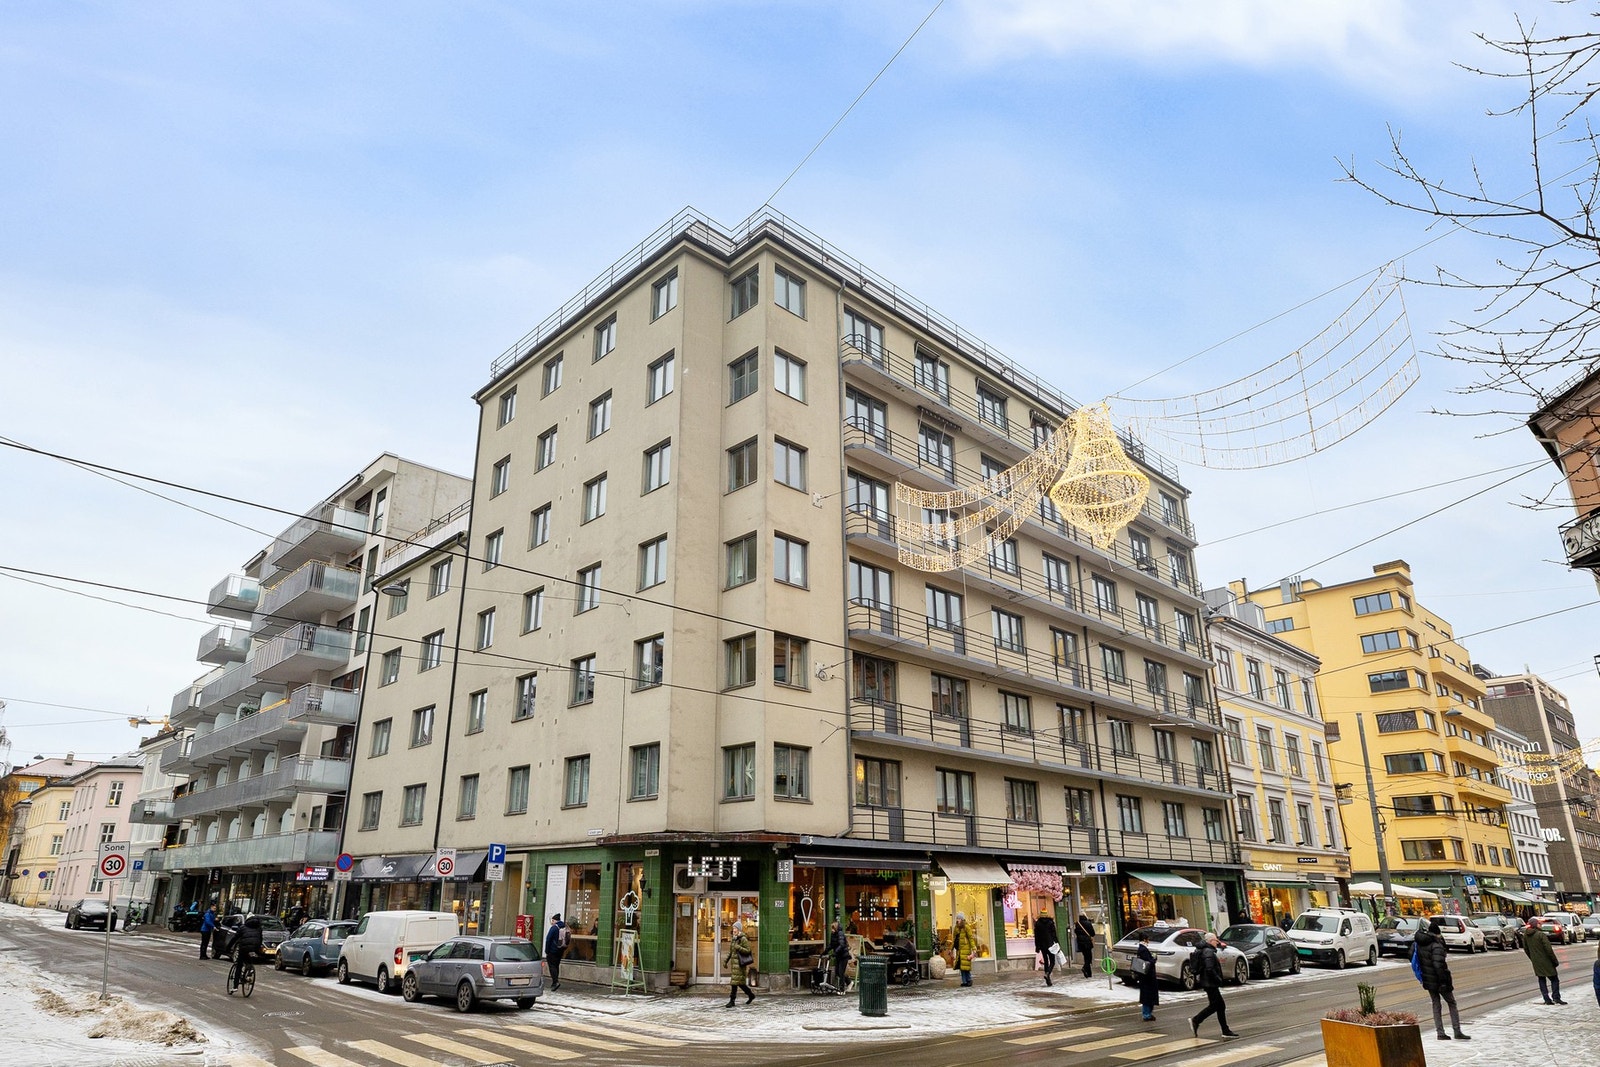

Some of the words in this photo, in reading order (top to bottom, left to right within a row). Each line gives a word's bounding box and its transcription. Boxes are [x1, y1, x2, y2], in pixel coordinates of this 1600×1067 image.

[104, 844, 125, 852] Sone
[492, 845, 502, 861] P
[105, 860, 121, 871] 30
[440, 861, 451, 871] 30
[687, 856, 741, 878] LETT
[1262, 863, 1282, 871] GANT
[1466, 877, 1473, 885] P
